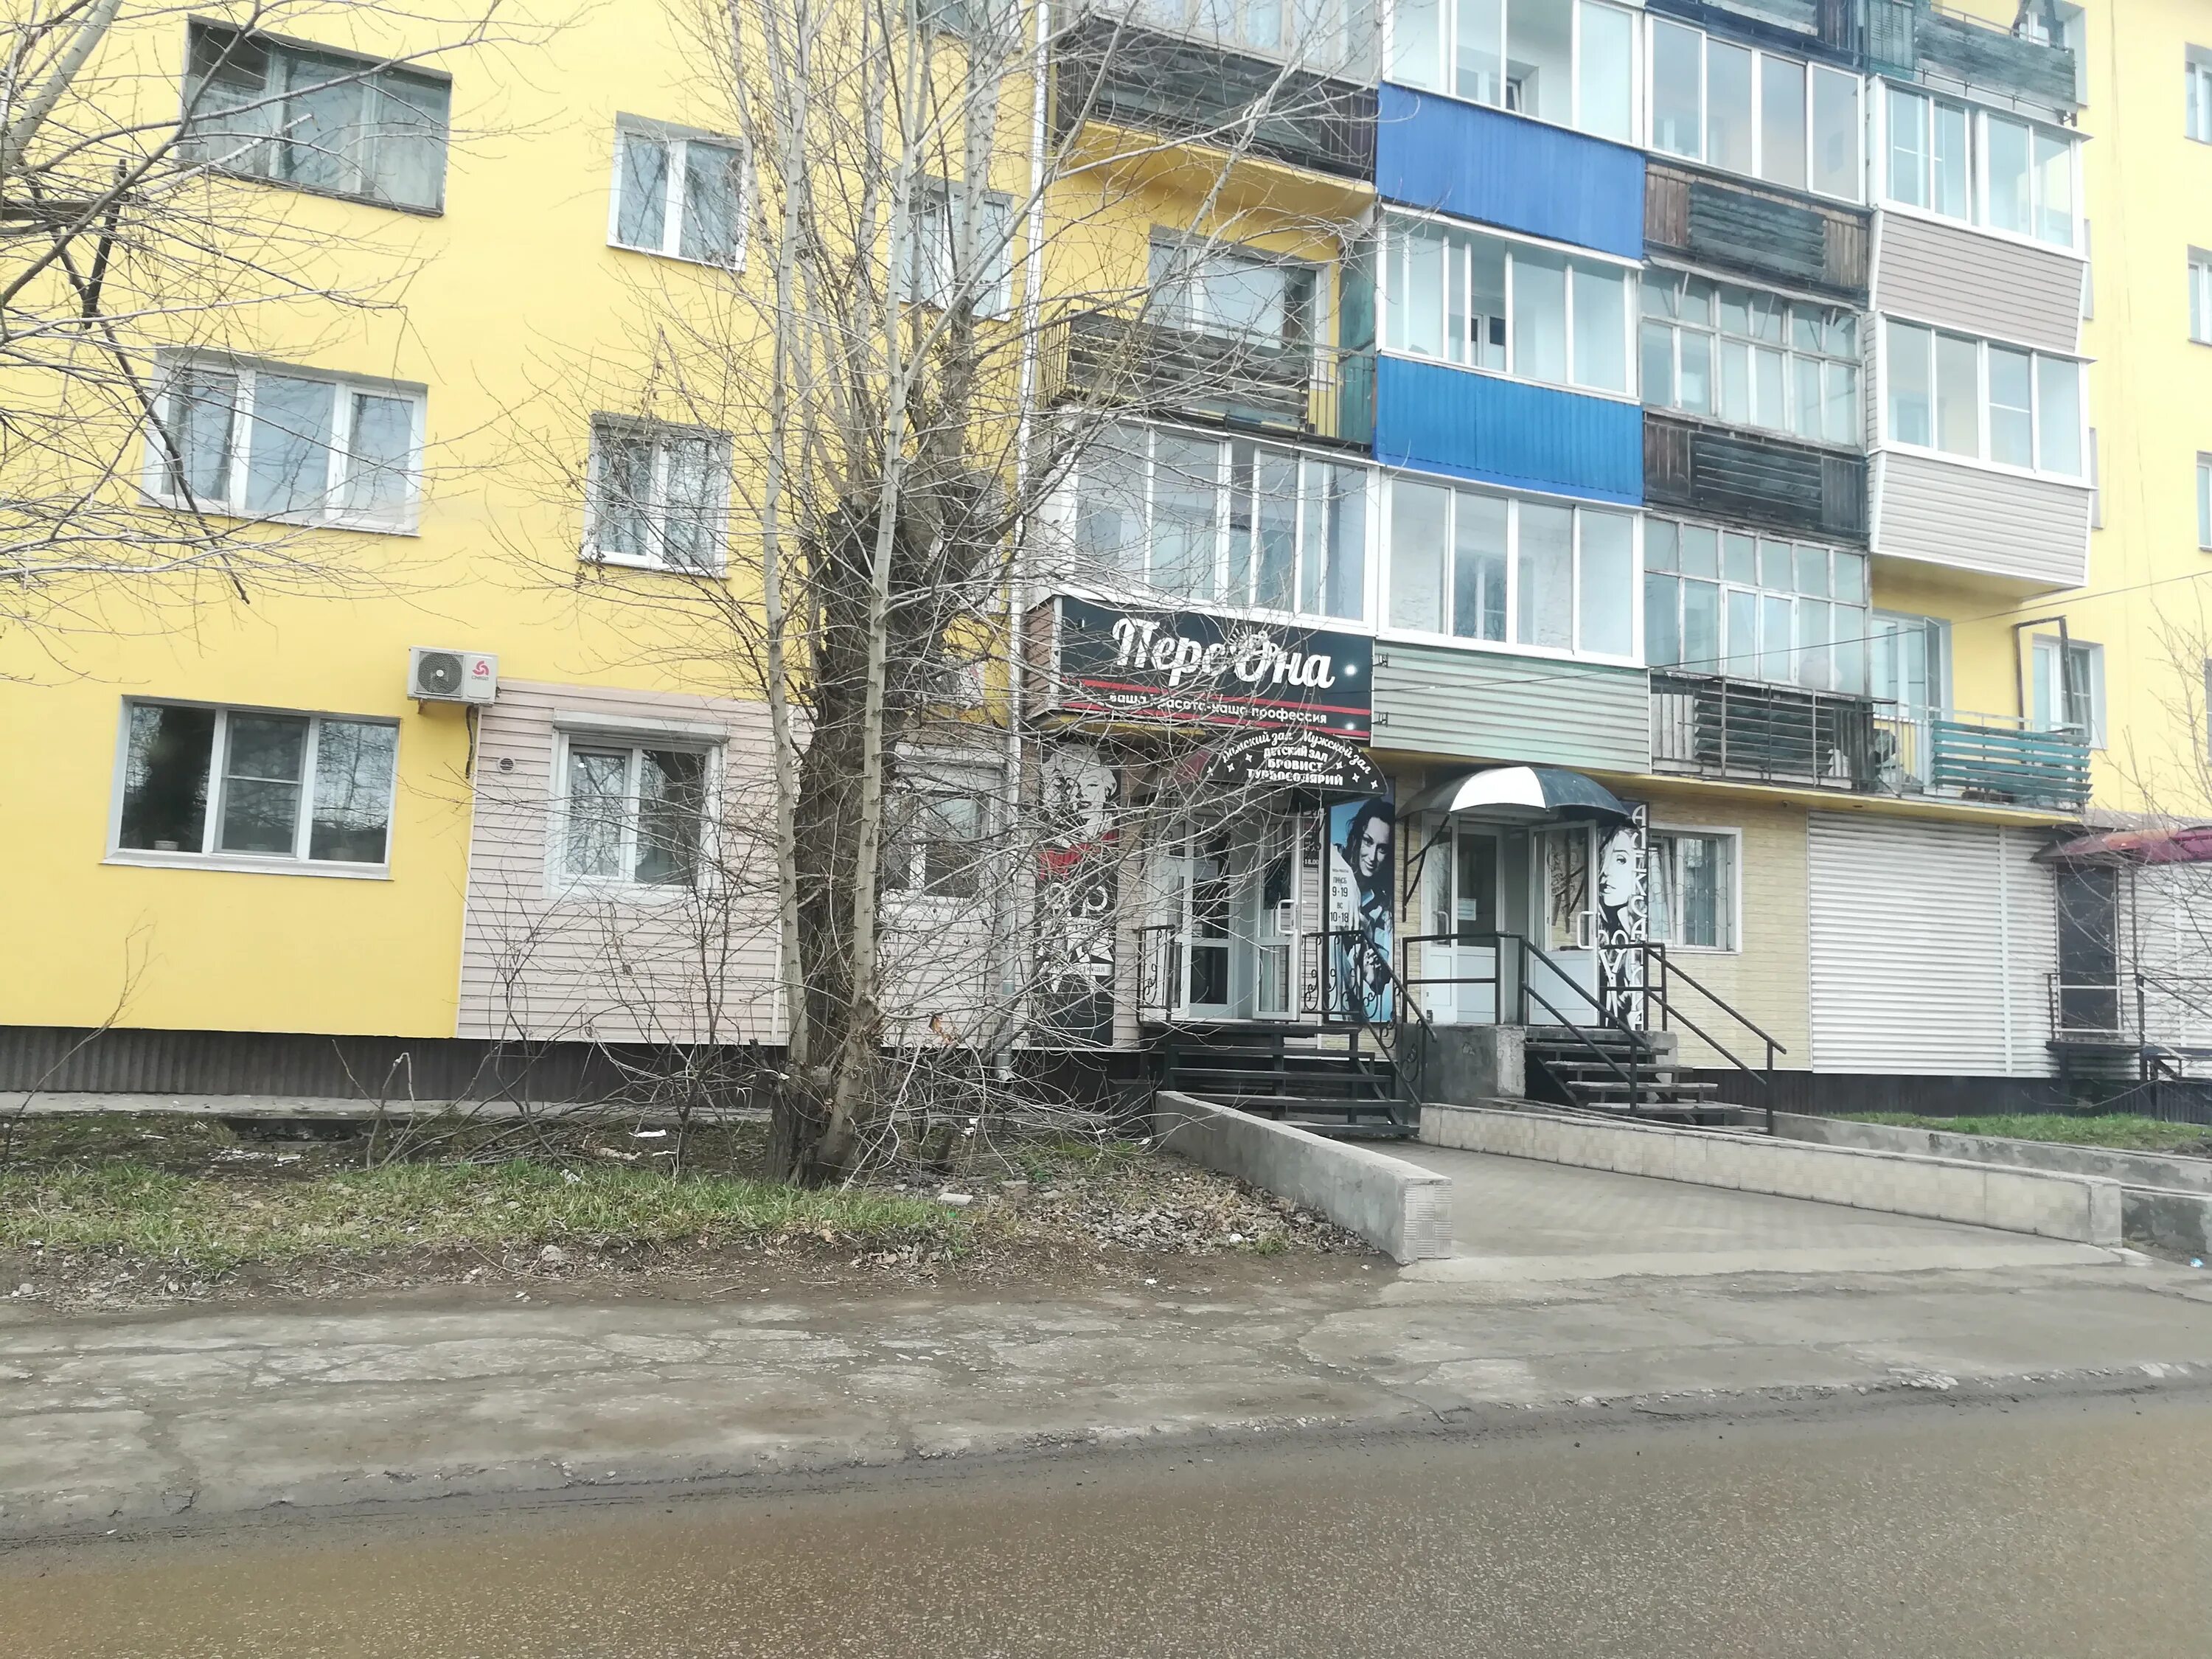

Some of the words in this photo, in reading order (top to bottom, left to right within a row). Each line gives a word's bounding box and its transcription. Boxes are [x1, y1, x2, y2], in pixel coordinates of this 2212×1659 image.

[1251, 707, 1327, 724] профессия
[1264, 745, 1307, 759] ДЕТСКИЙ
[1309, 749, 1328, 762] ЗАЛ
[1302, 731, 1353, 758] Мужской
[1349, 754, 1371, 774] зал
[1267, 758, 1324, 772] БРОВИСТ
[1246, 768, 1343, 786] ТУРБОСОЛЯРИЙ
